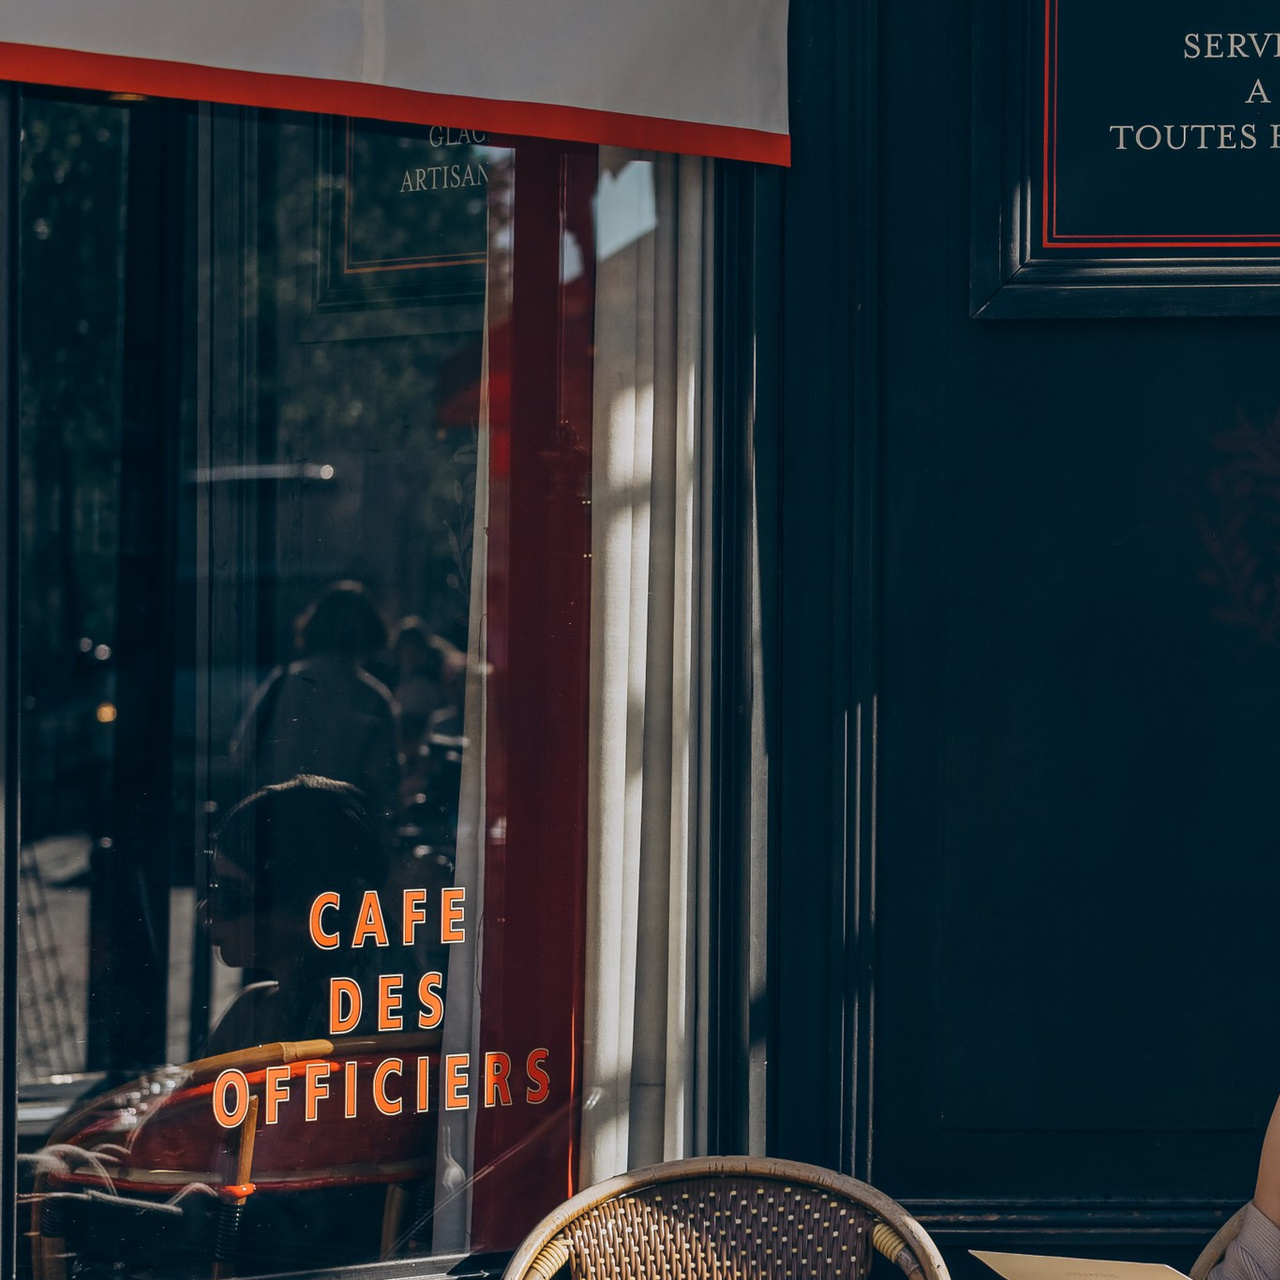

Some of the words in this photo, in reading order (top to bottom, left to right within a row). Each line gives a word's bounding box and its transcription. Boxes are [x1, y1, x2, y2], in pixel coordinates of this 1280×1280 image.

[1244, 78, 1272, 104] A
[429, 125, 490, 148] GLAC
[1109, 123, 1257, 151] TOUTES
[308, 886, 466, 951] CAFE
[329, 971, 445, 1035] DES
[213, 1047, 551, 1129] OFFICIERS
